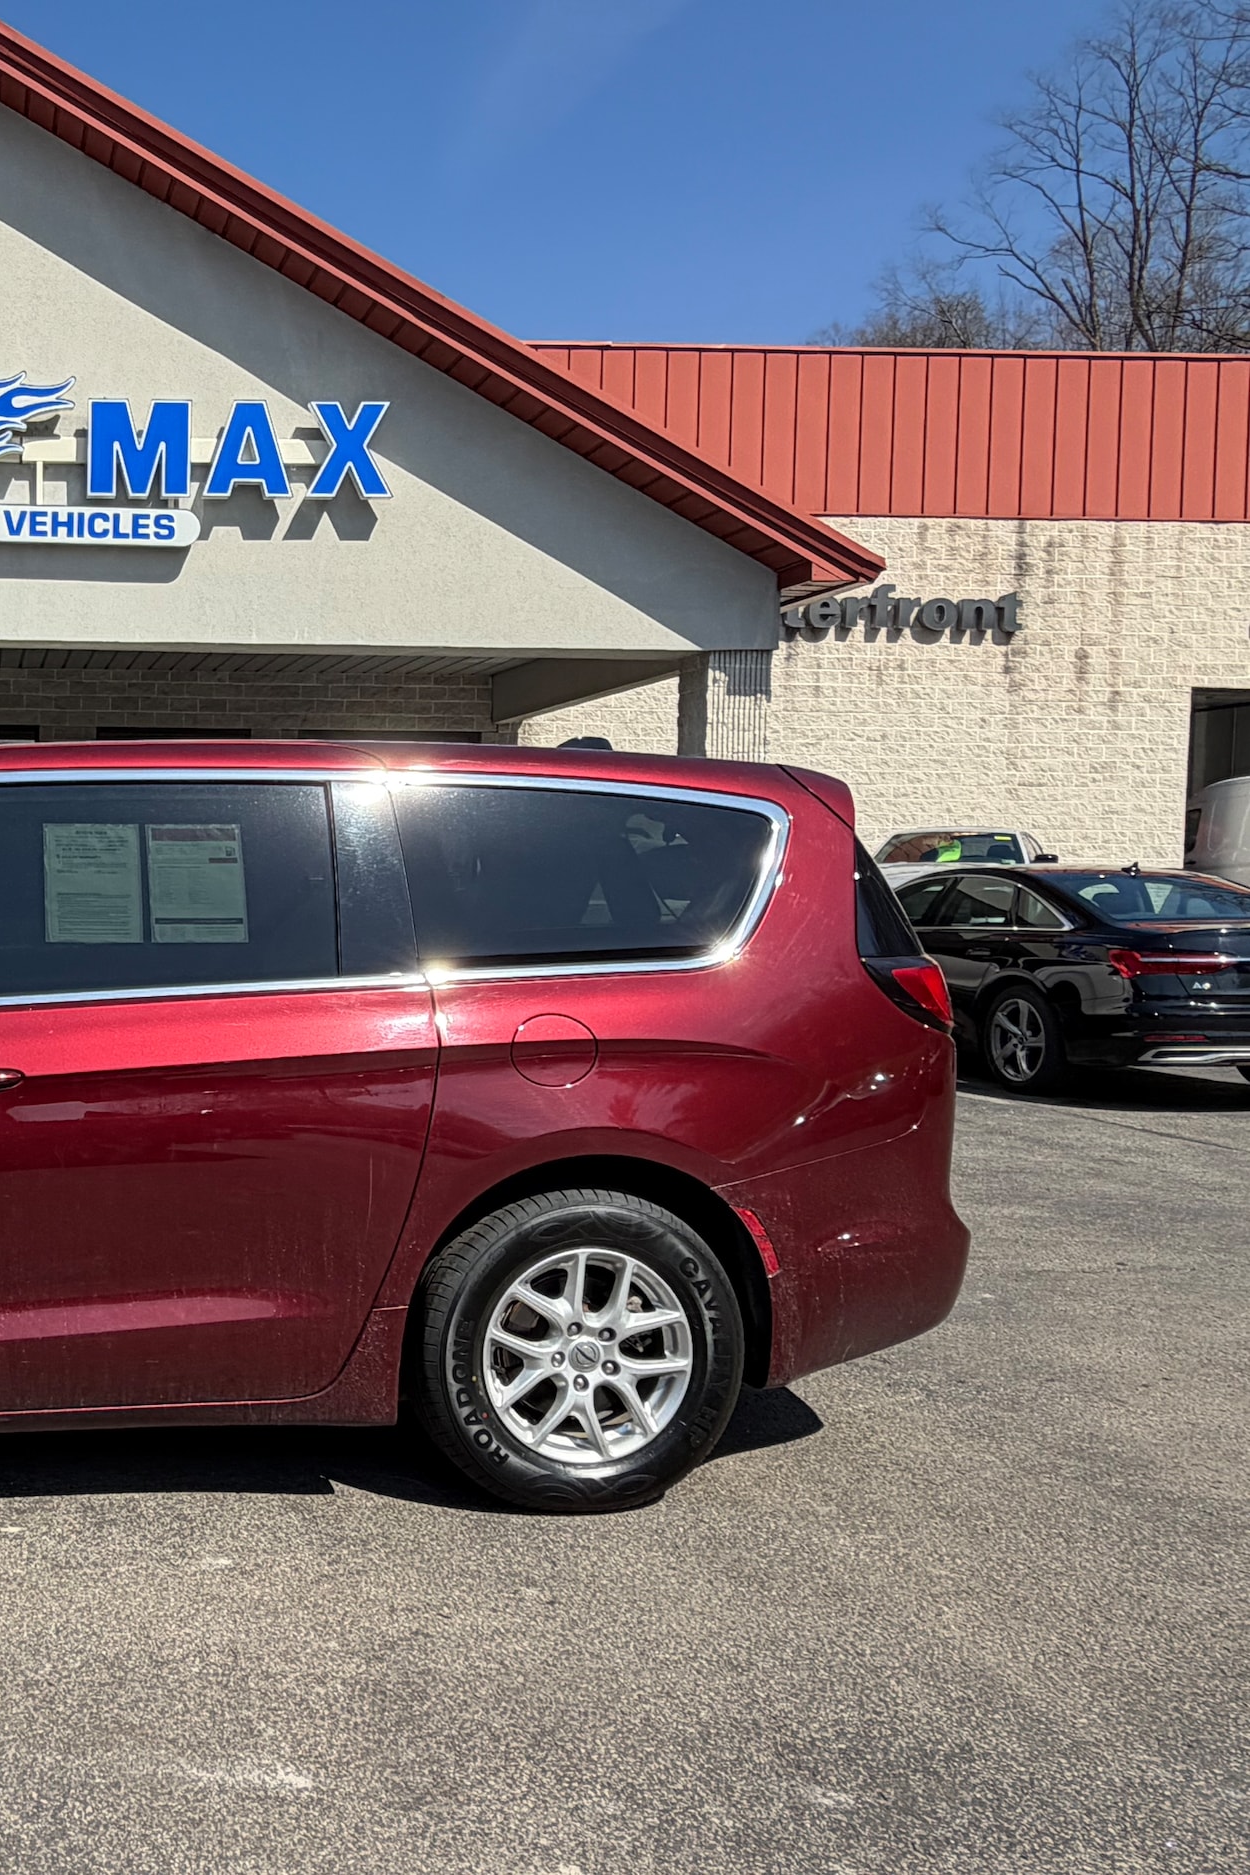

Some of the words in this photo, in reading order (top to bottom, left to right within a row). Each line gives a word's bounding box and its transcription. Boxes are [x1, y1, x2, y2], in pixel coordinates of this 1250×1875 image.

[86, 397, 394, 500] MAX
[3, 509, 176, 541] VEHICLES
[451, 1317, 511, 1467] ROADONE
